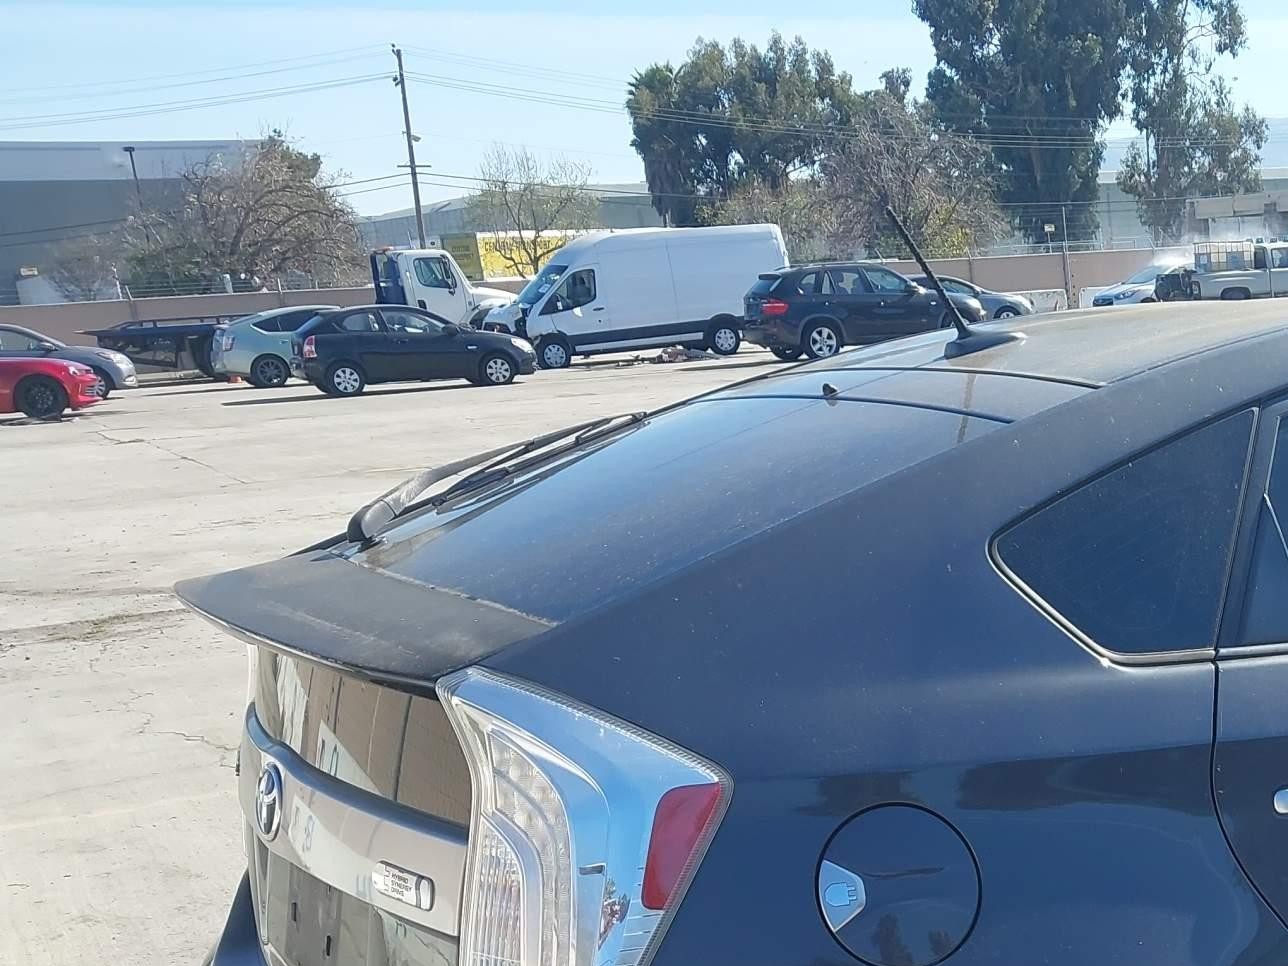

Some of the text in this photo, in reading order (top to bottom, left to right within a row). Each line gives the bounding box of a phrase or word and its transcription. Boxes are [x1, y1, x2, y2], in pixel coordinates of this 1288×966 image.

[391, 872, 409, 884] HYBRID
[390, 879, 413, 892] SYNERGY
[390, 886, 405, 897] DRIVE
